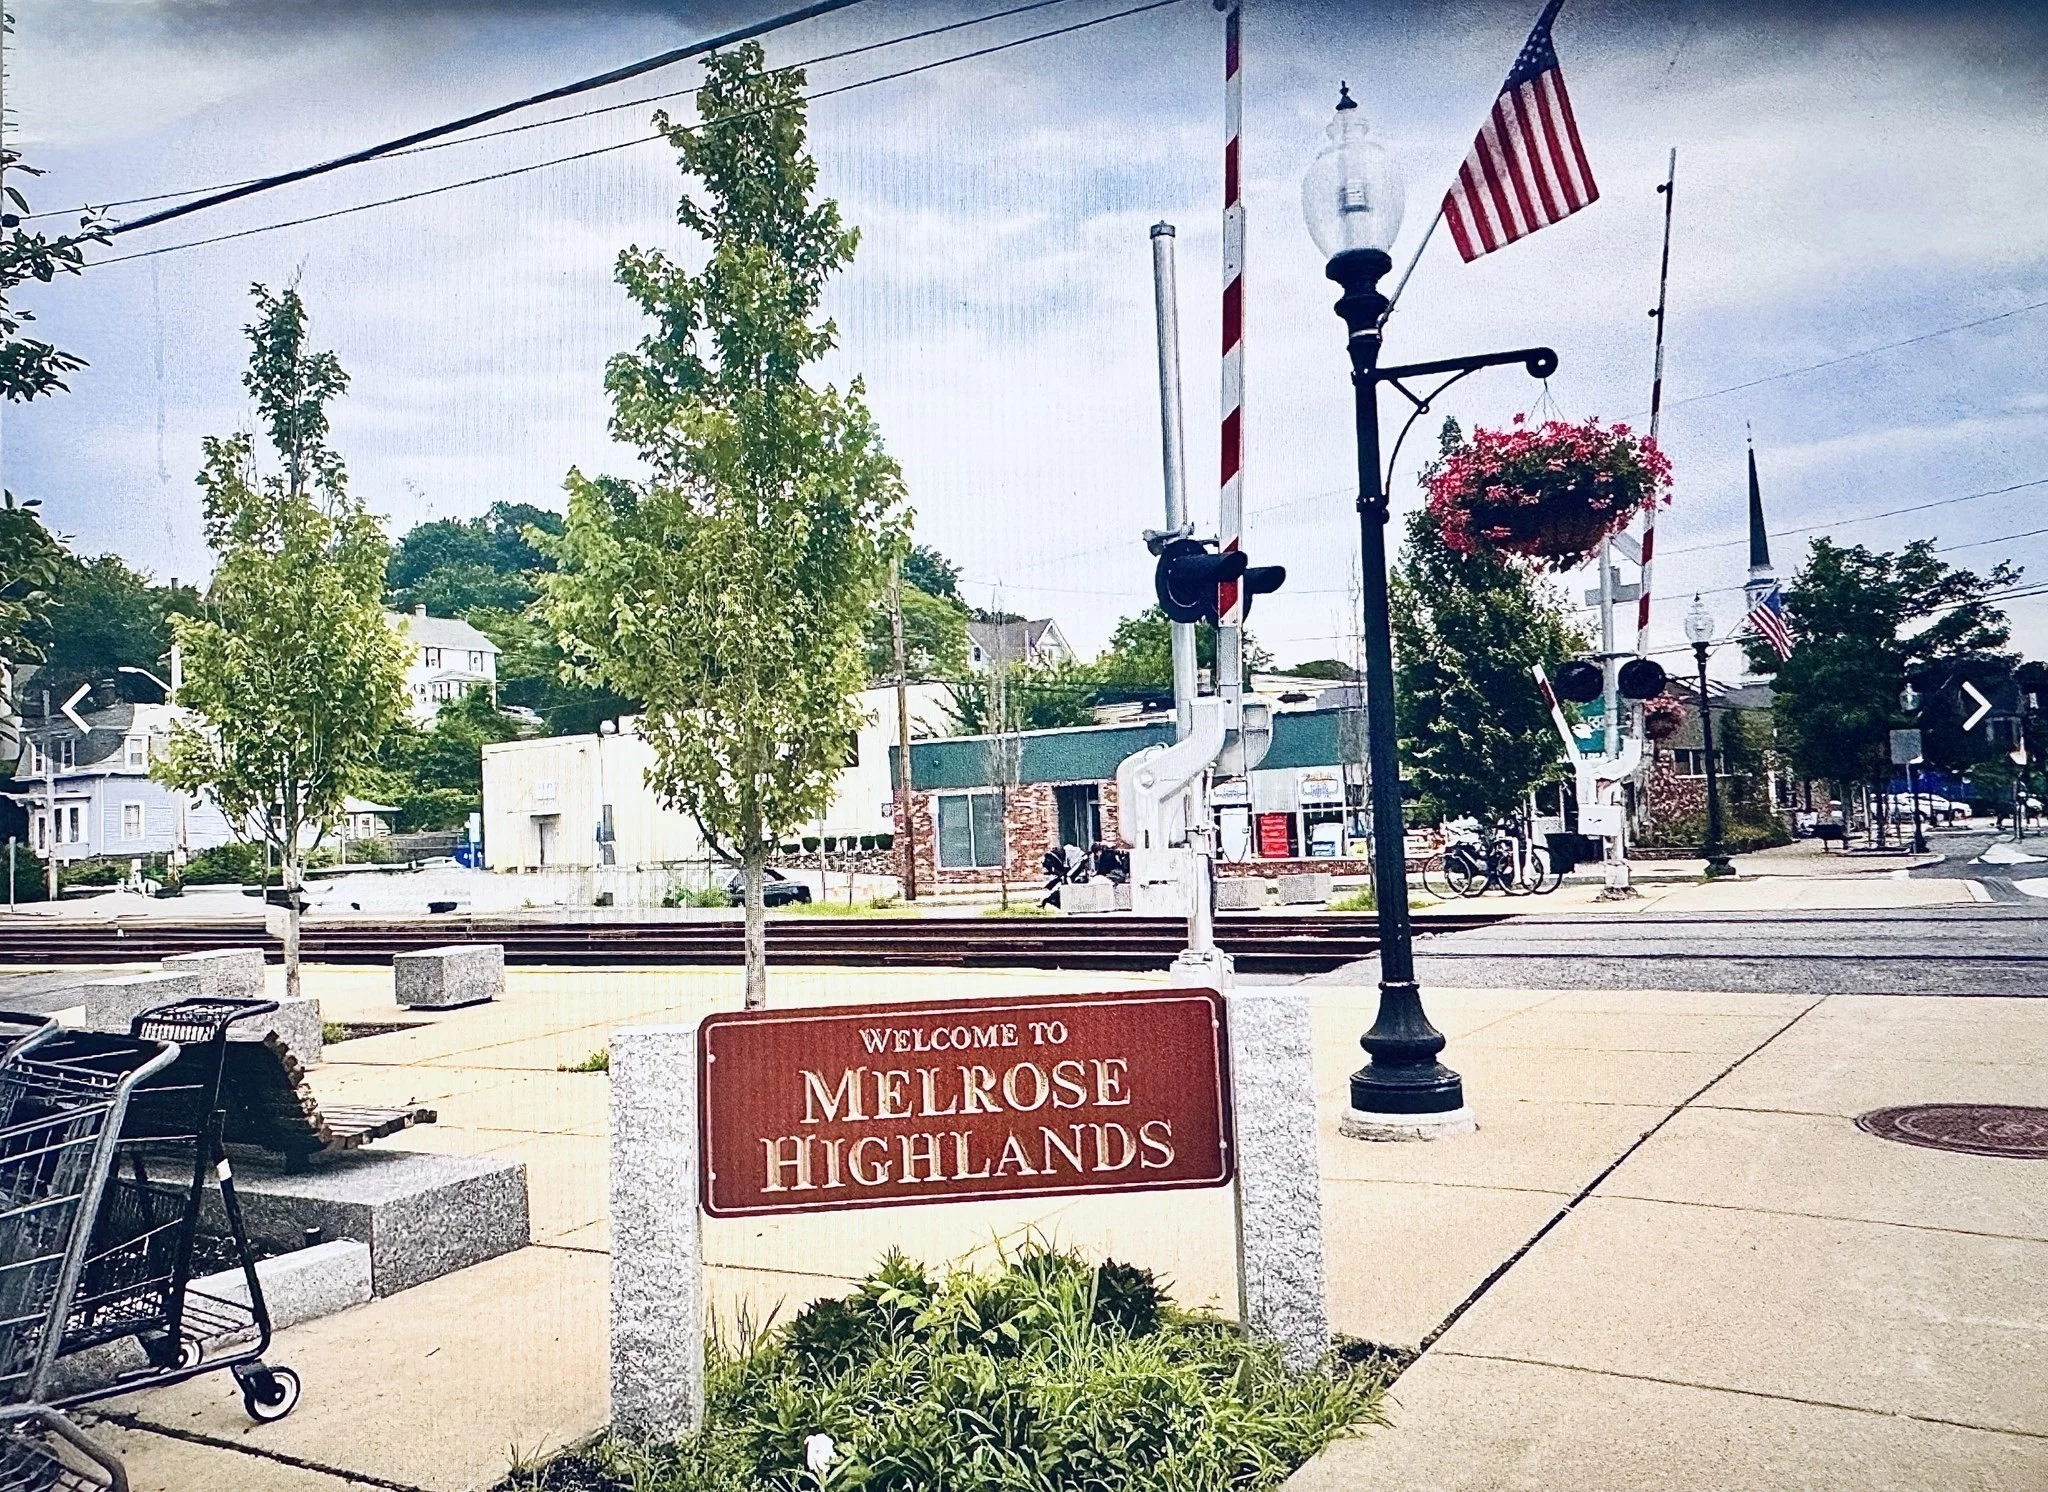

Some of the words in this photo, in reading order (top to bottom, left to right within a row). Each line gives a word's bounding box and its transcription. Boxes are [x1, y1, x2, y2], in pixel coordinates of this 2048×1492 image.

[858, 1022, 1019, 1054] WELCOME
[1028, 1020, 1069, 1046] TO
[799, 1057, 1131, 1124] MELROSE
[759, 1119, 1176, 1193] HIGHLANDS
